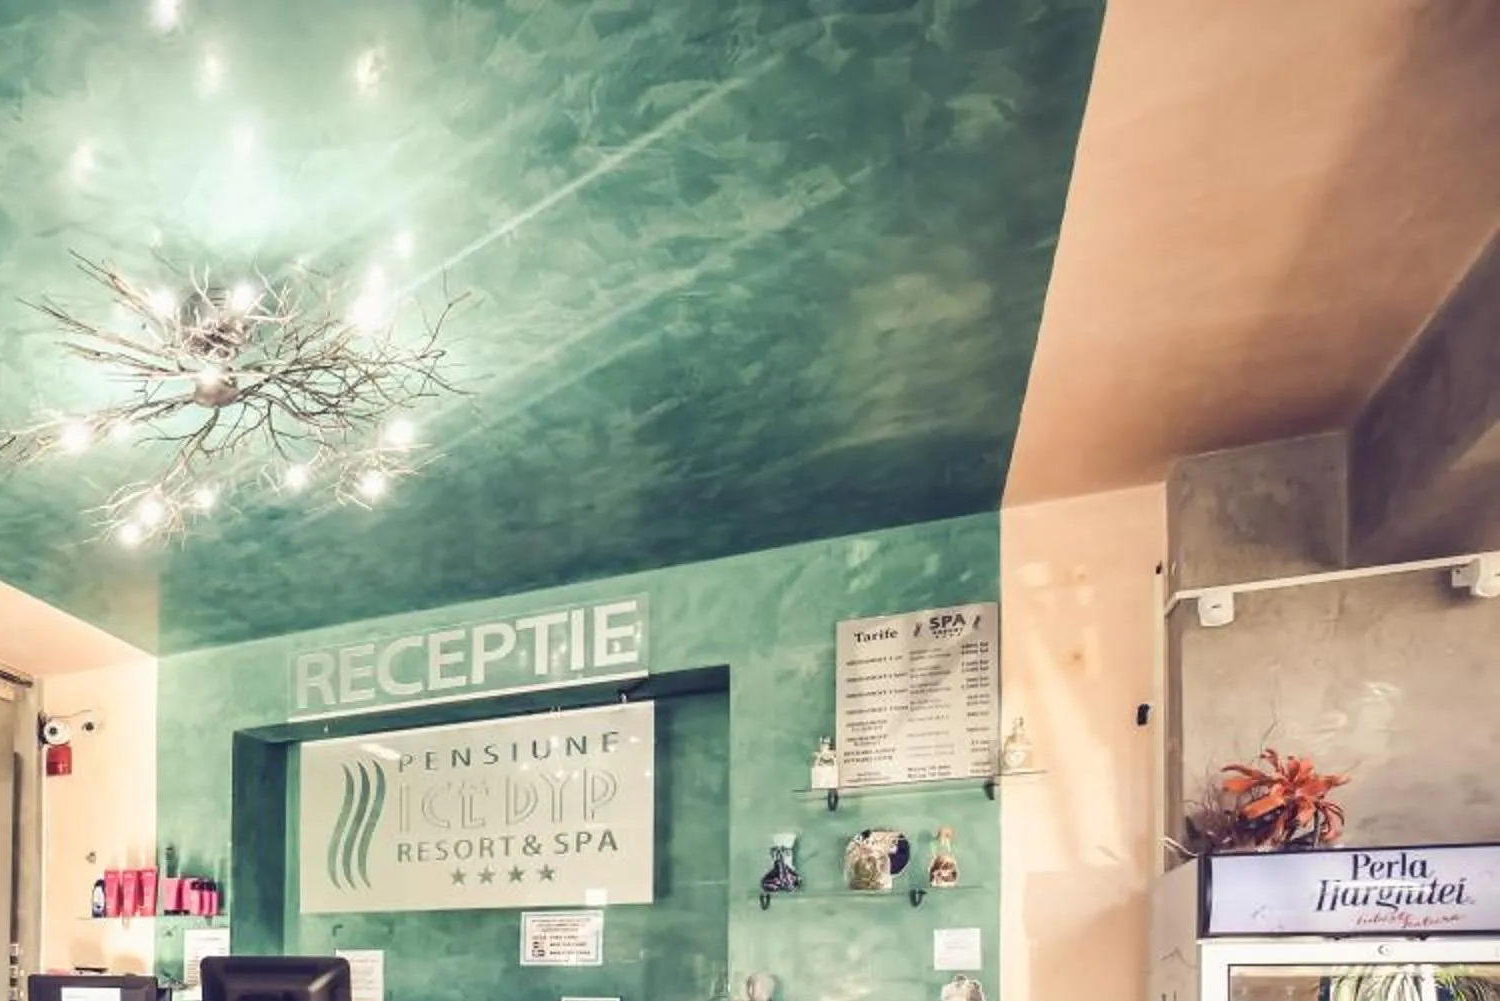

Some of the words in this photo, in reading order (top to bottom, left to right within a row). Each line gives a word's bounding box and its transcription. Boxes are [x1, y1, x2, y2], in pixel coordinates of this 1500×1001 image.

[853, 627, 899, 643] Tarife
[929, 614, 967, 631] SPA
[296, 600, 637, 708] RECEPTIE
[398, 731, 620, 772] PENSIUNE
[397, 835, 514, 863] RESORT
[522, 835, 543, 857] &
[554, 829, 619, 855] SPA
[1352, 852, 1429, 881] Perla
